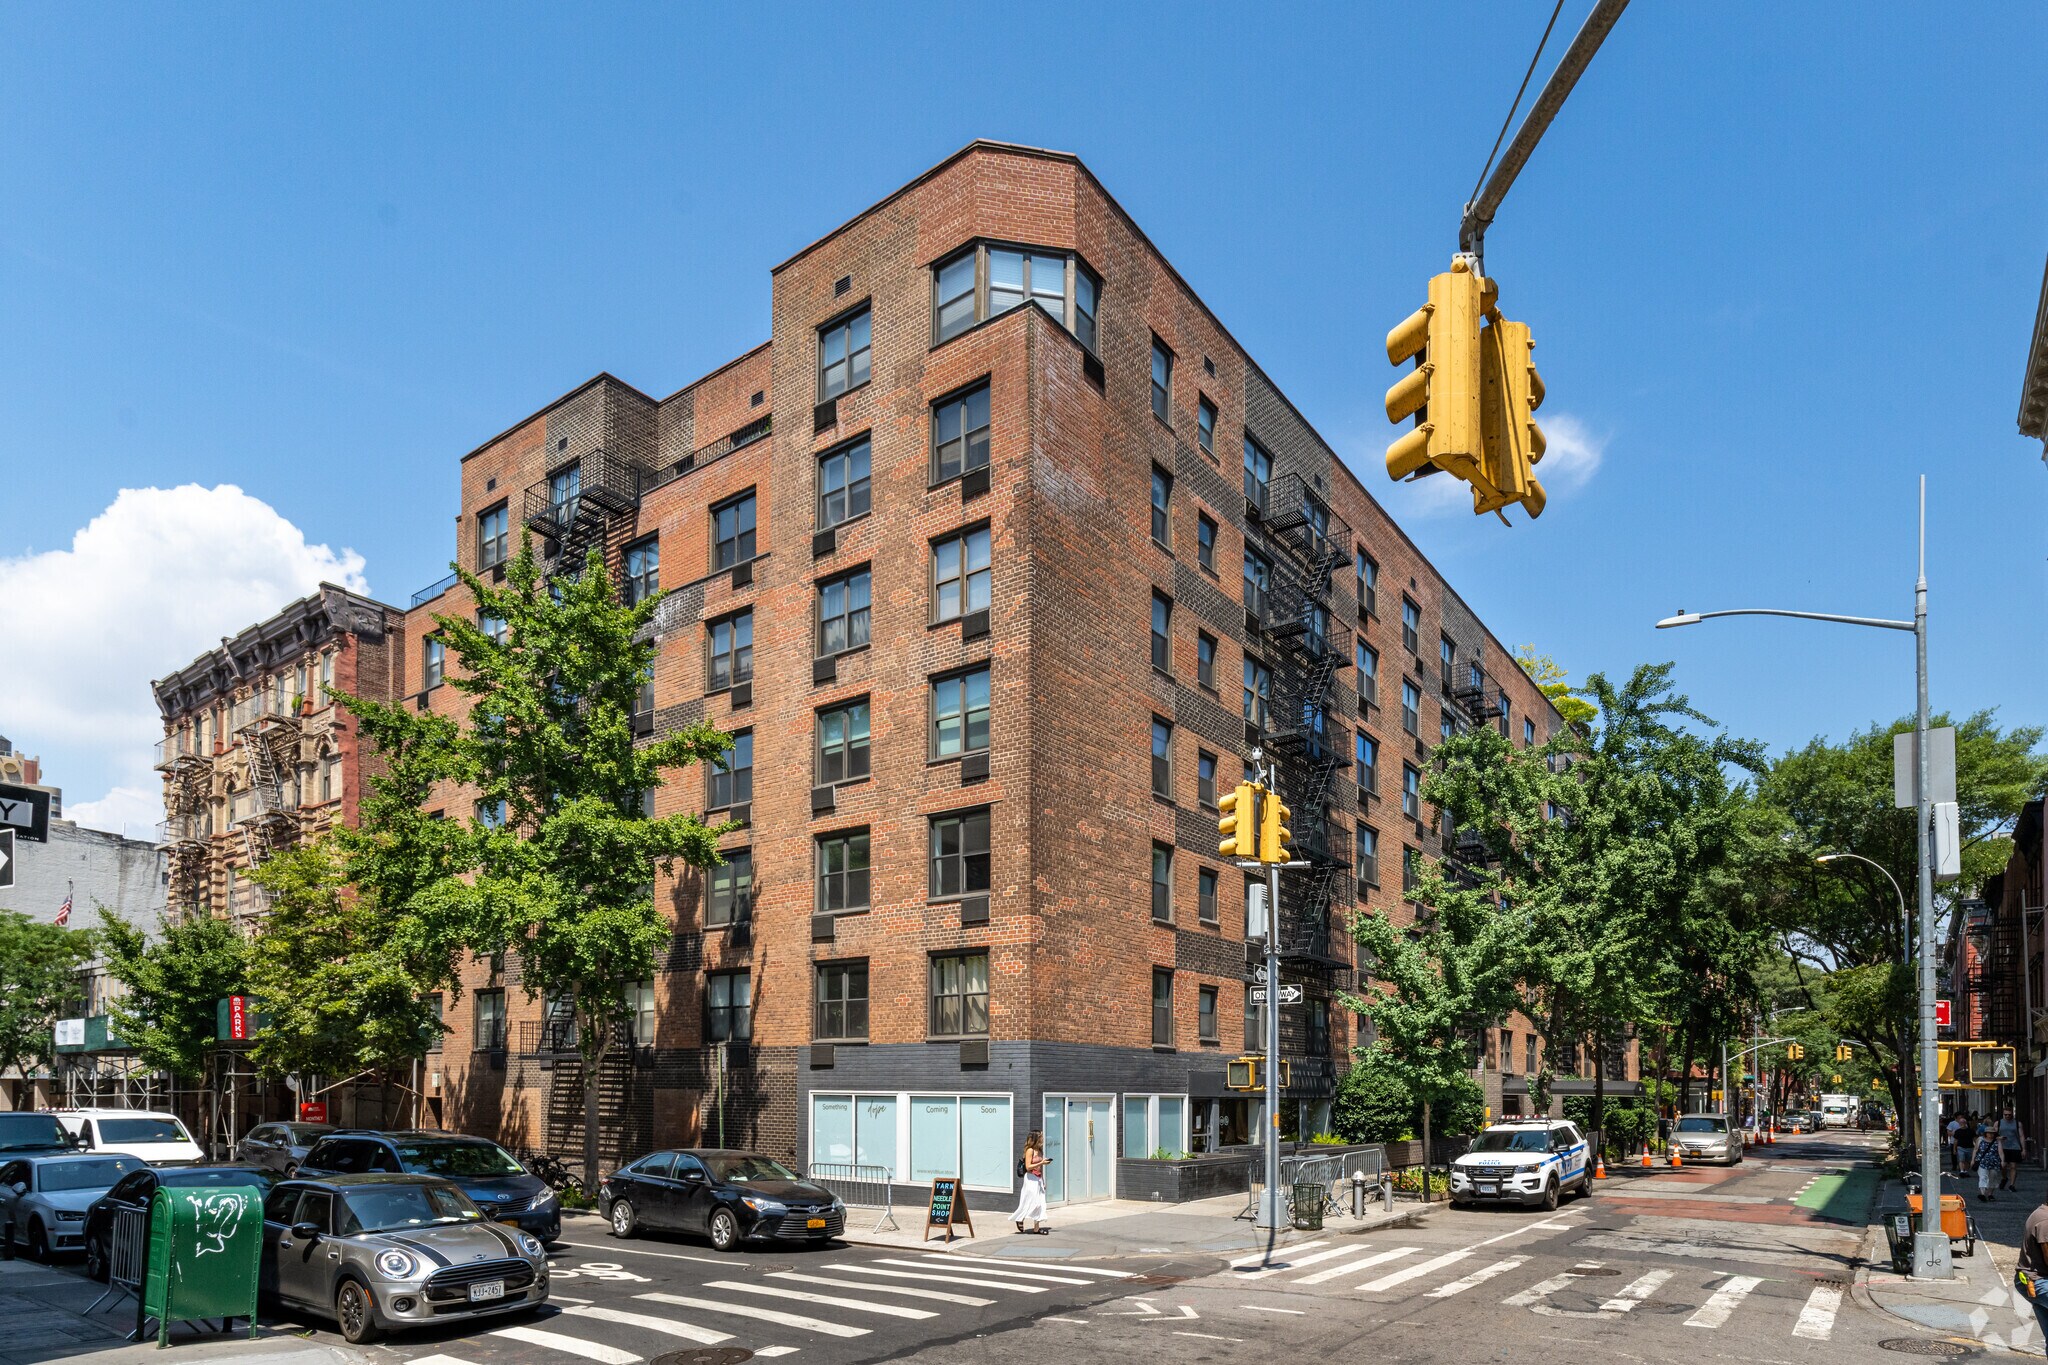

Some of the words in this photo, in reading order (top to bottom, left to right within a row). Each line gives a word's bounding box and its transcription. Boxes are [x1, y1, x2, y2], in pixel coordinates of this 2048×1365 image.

[0, 801, 18, 821] Y
[1280, 990, 1296, 998] WAY
[234, 1005, 242, 1032] PARK
[822, 1103, 848, 1112] Something
[925, 1105, 949, 1114] Coming
[980, 1105, 997, 1113] Soon
